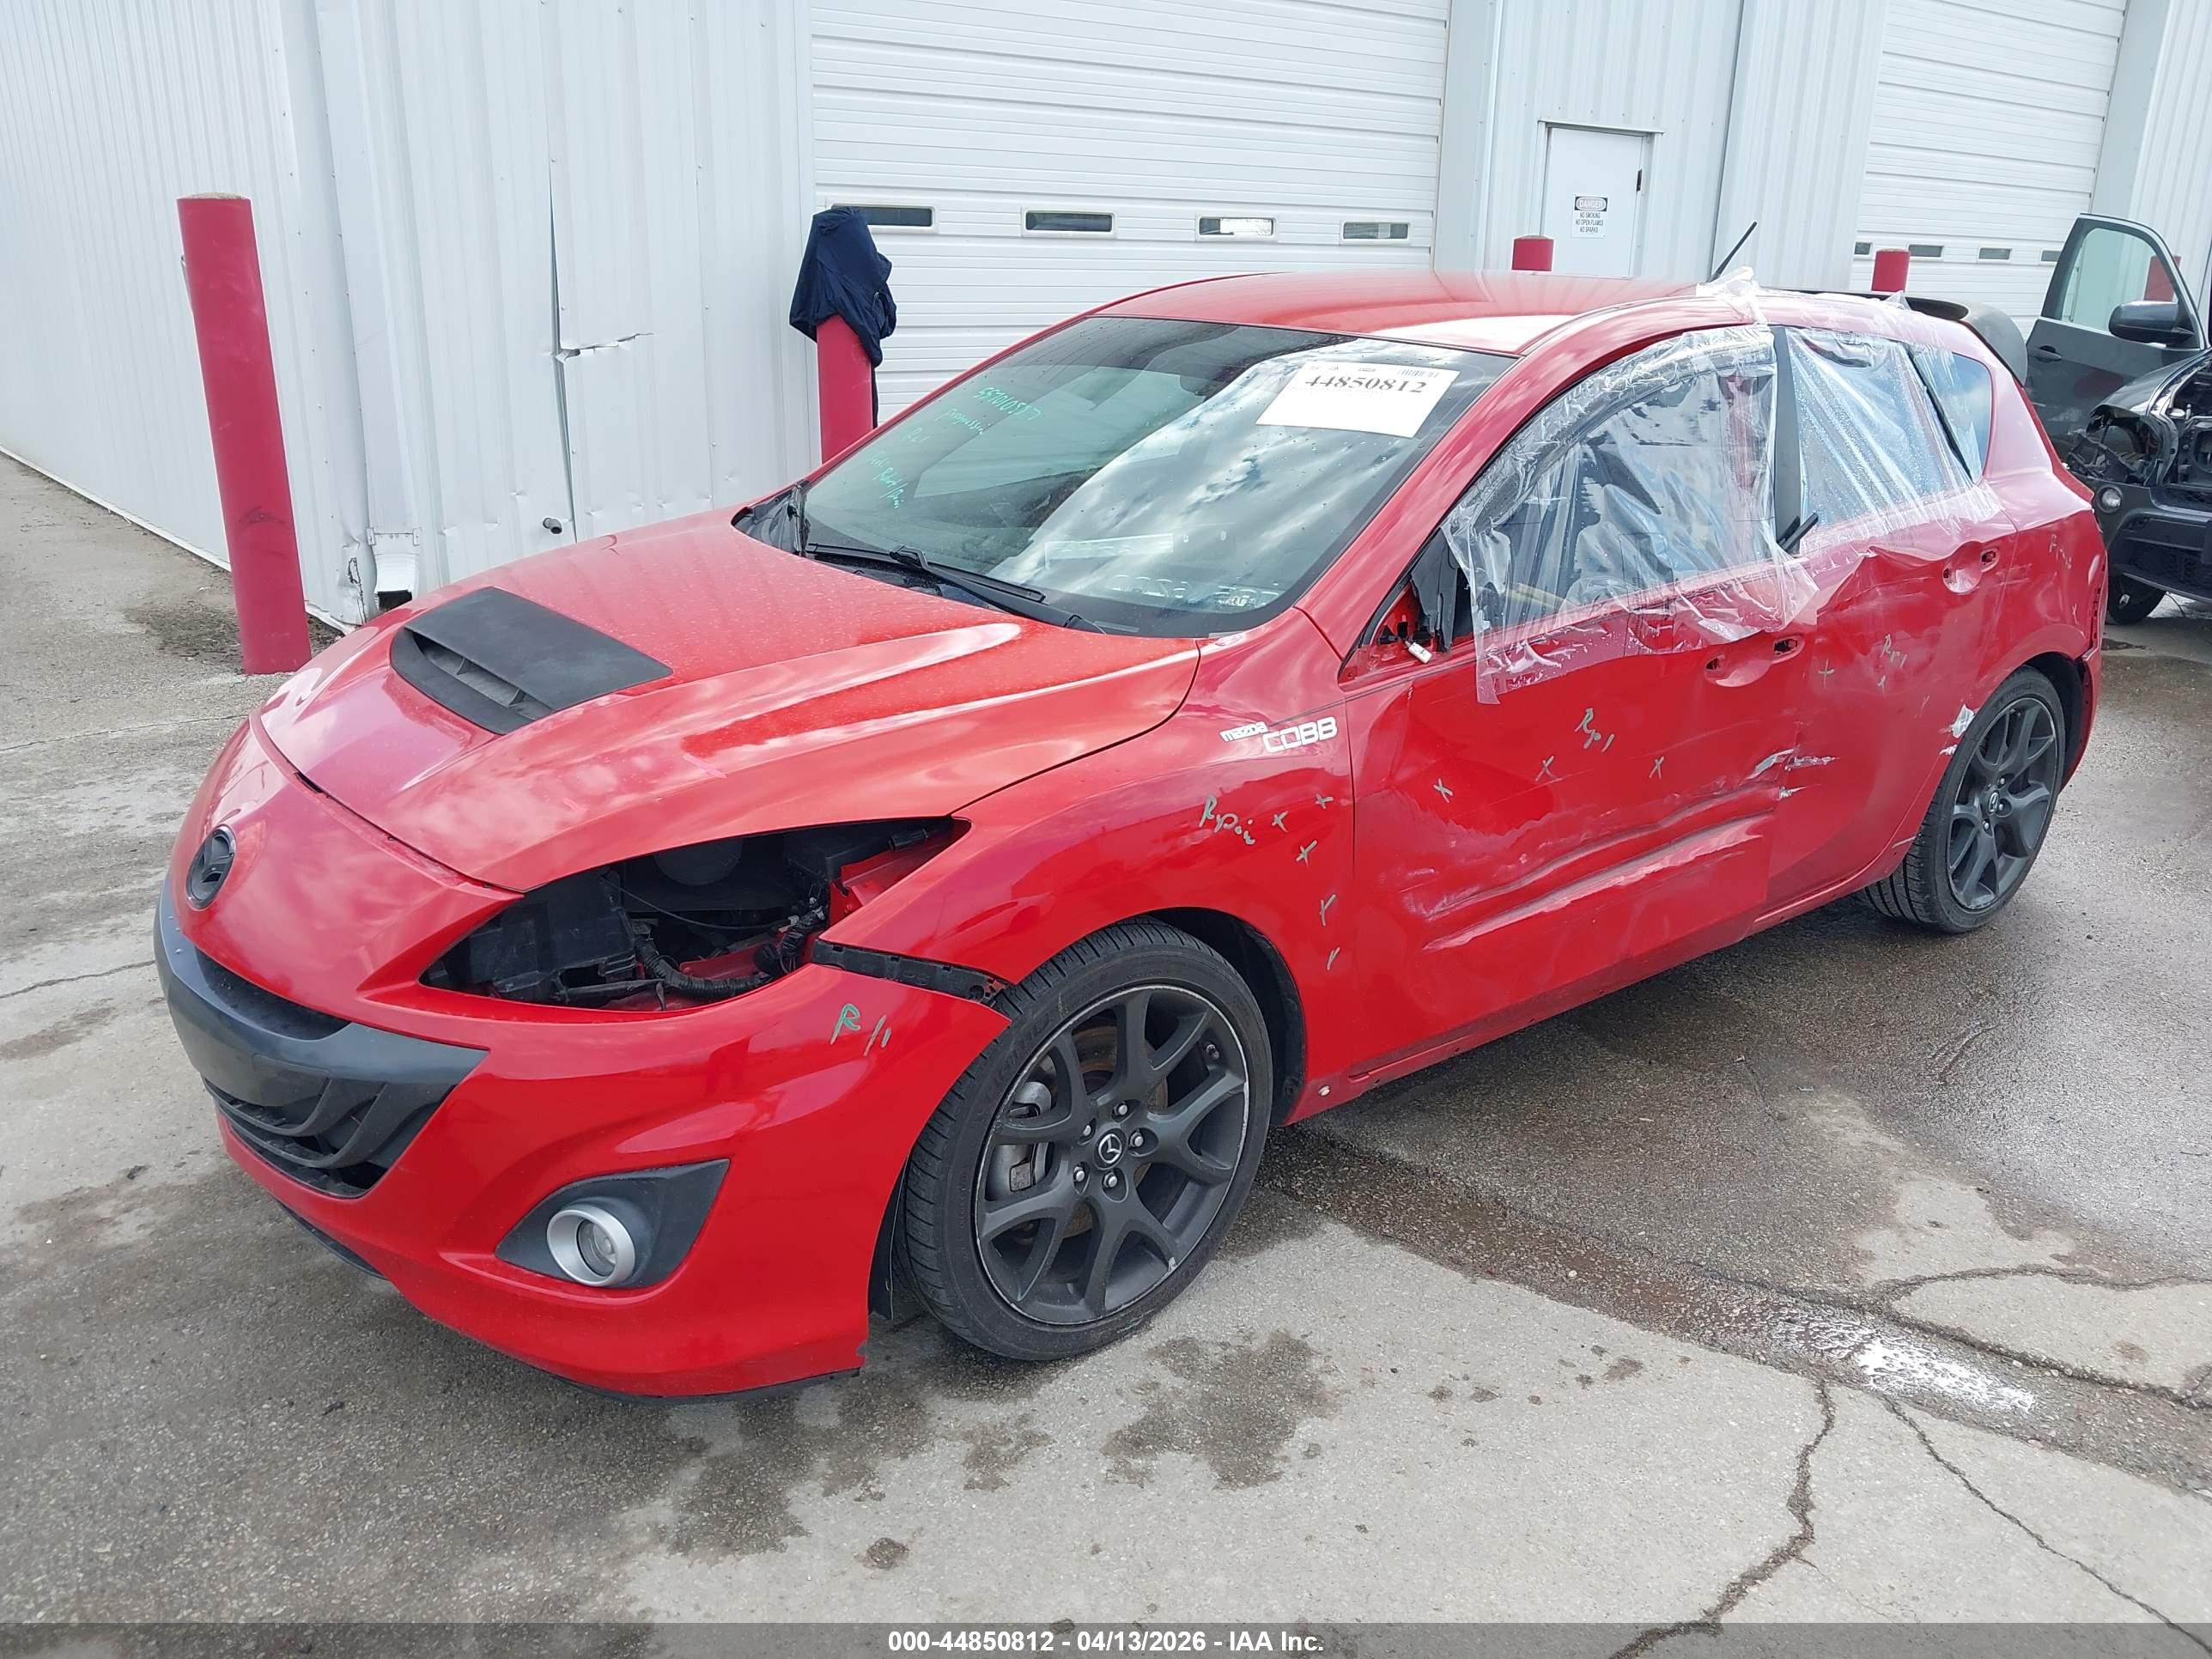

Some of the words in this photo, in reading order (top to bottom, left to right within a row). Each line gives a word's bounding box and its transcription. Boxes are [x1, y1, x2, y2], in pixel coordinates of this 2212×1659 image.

[1579, 199, 1603, 208] DANGER
[1305, 374, 1427, 393] 44850812
[1262, 716, 1338, 753] COBB
